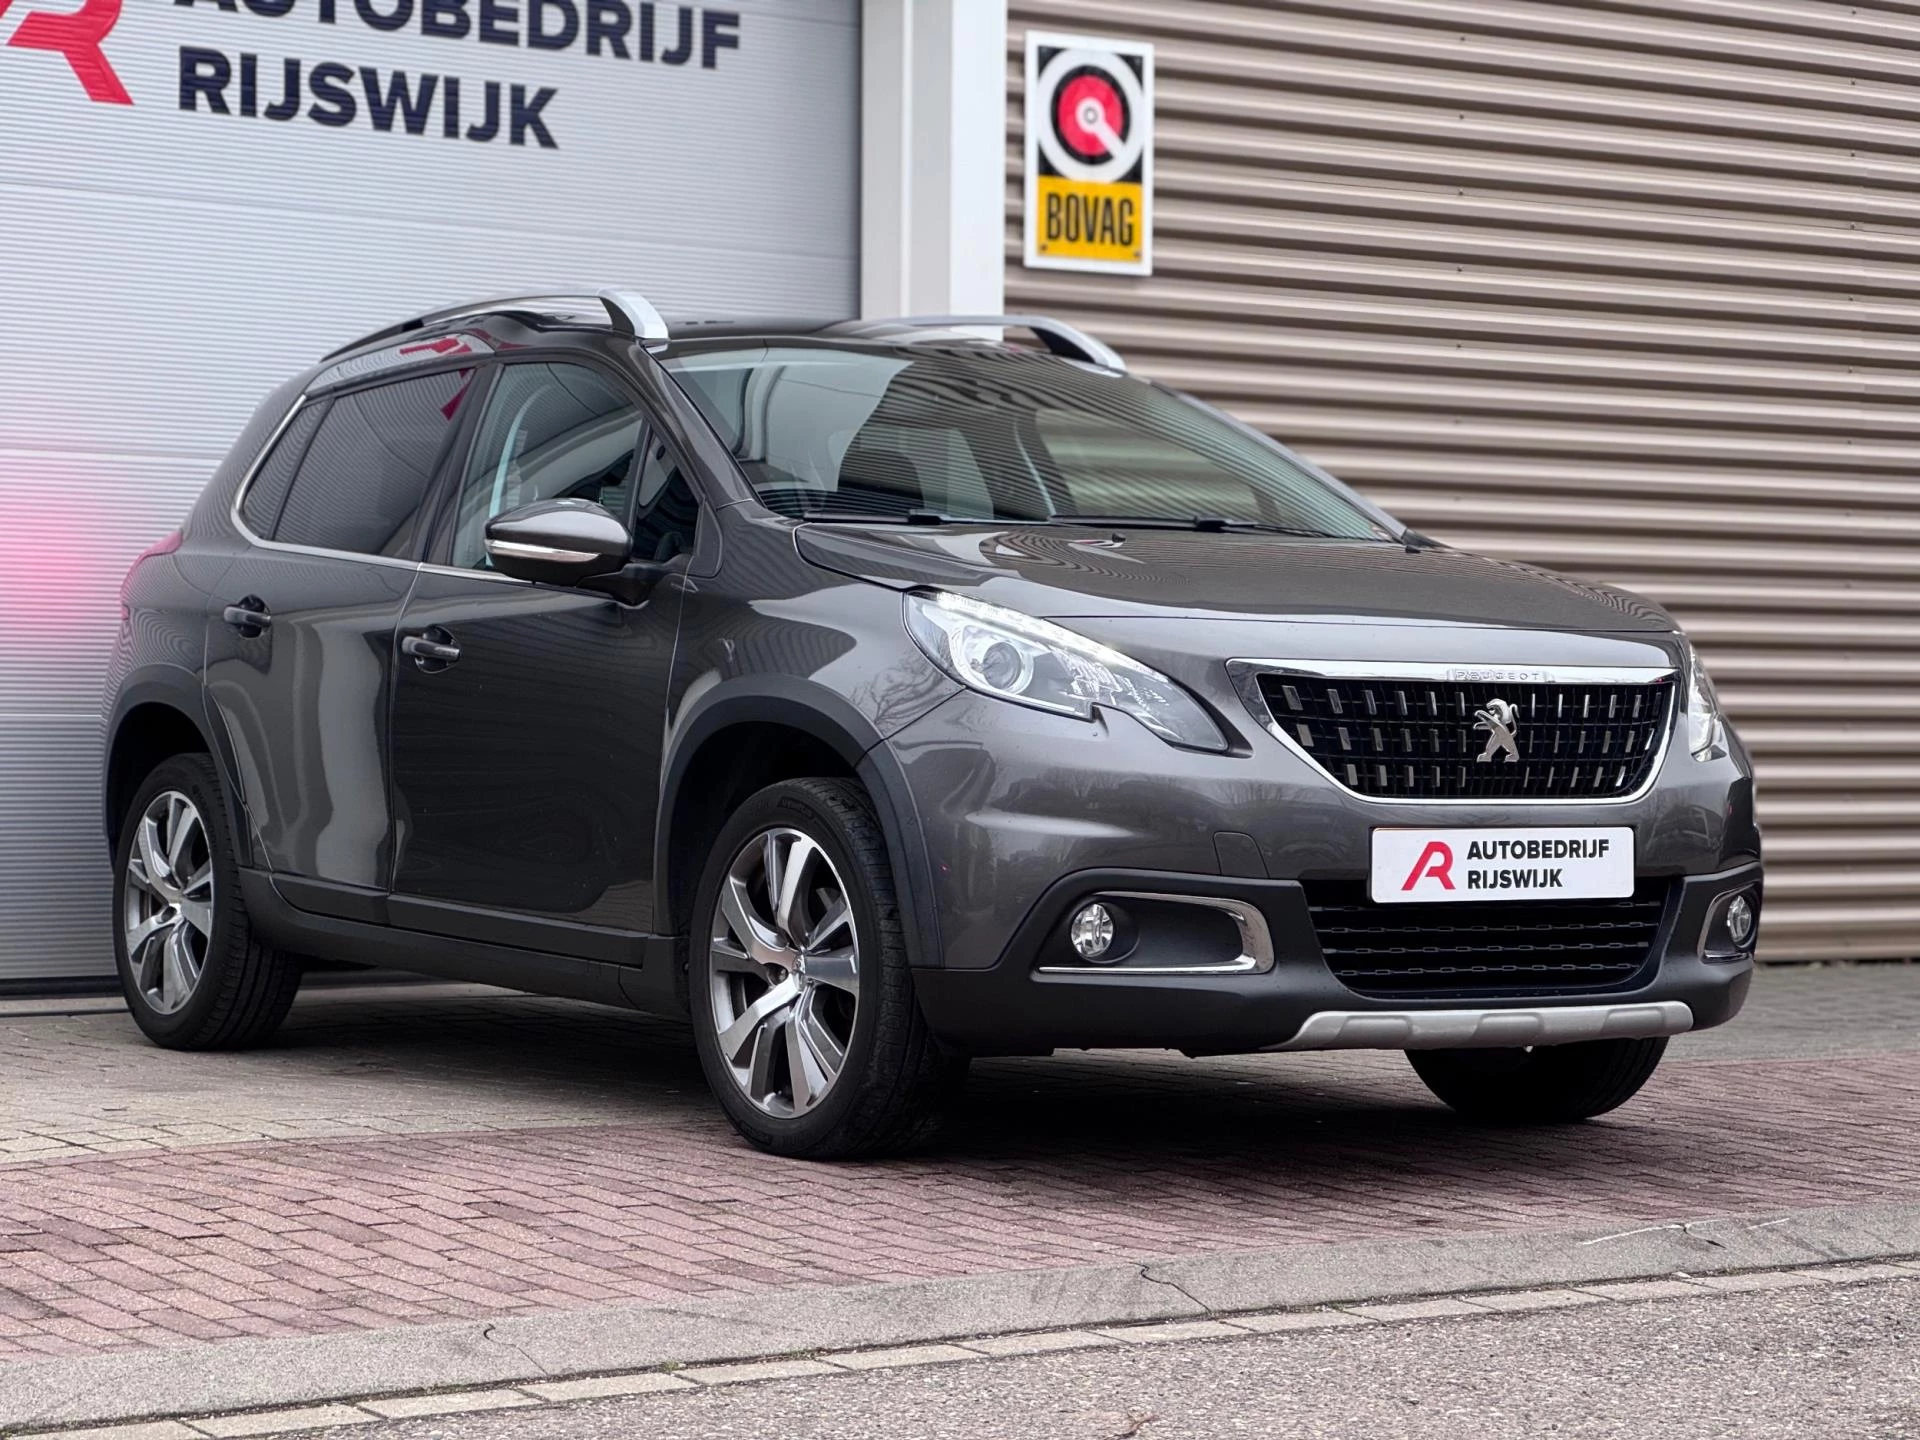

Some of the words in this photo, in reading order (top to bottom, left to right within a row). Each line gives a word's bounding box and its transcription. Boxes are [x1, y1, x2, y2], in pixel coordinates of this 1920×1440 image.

[174, 0, 740, 69] BEDRIJF
[179, 46, 558, 149] RIJSWIJK
[1047, 193, 1133, 247] BOVAG
[1456, 670, 1541, 681] PEUGEOT
[1467, 839, 1609, 860] AUTOBEDRIJF
[1467, 868, 1563, 889] RIJSWIJK
